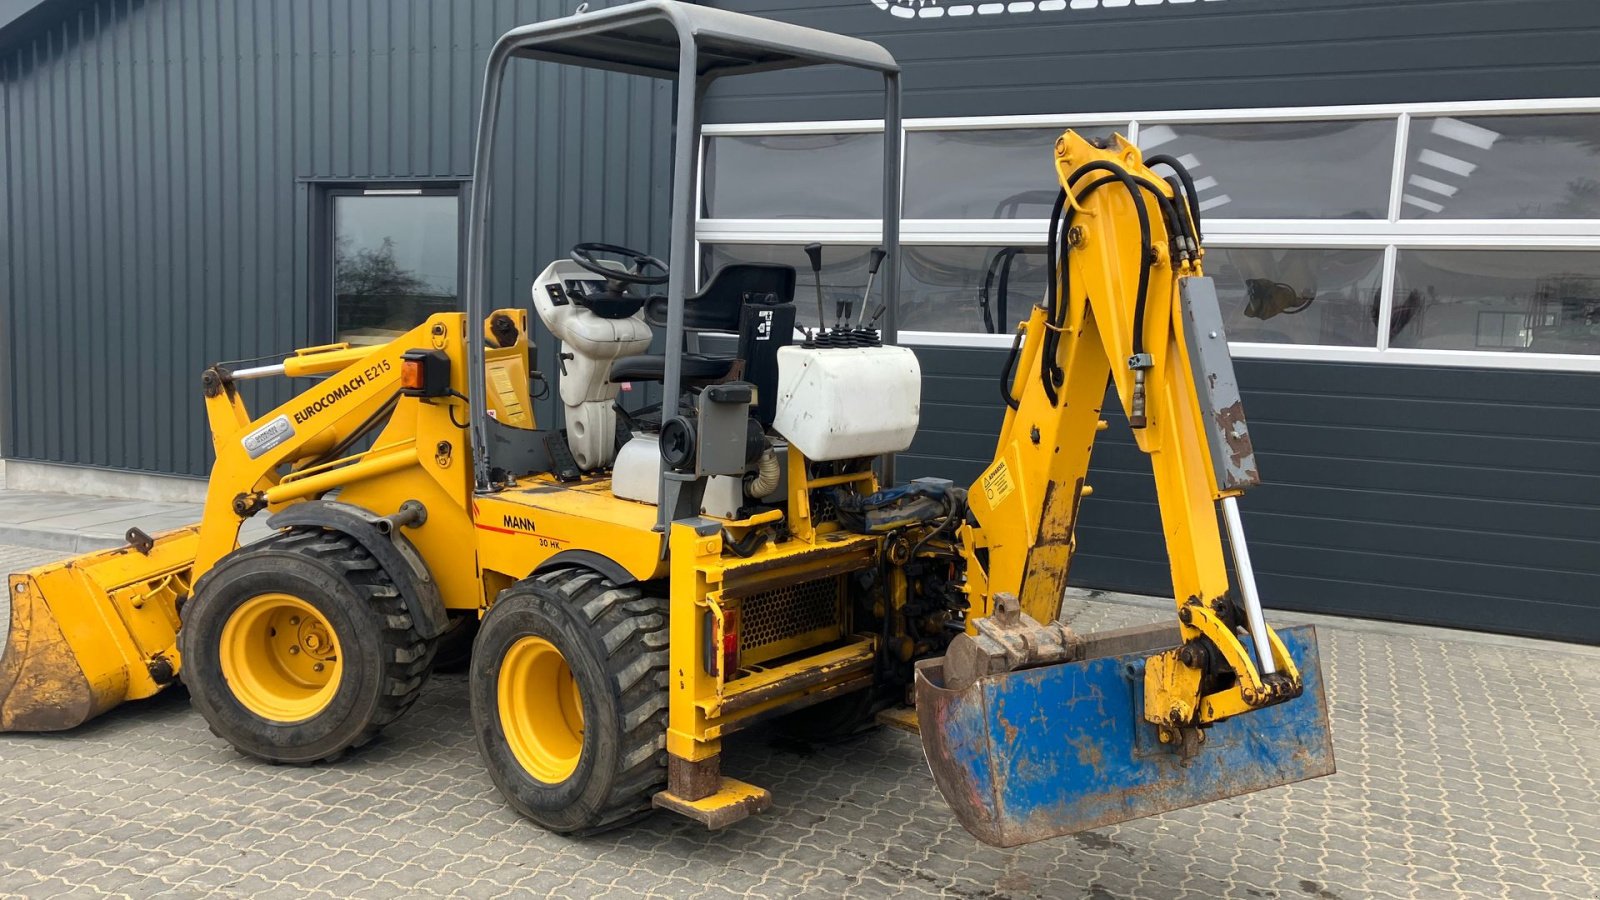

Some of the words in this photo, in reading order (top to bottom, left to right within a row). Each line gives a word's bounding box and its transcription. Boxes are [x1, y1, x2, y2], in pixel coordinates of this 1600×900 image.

[293, 375, 366, 425] EUROCOMACH
[364, 359, 391, 382] E215
[503, 514, 536, 532] MANN
[539, 538, 548, 547] 30
